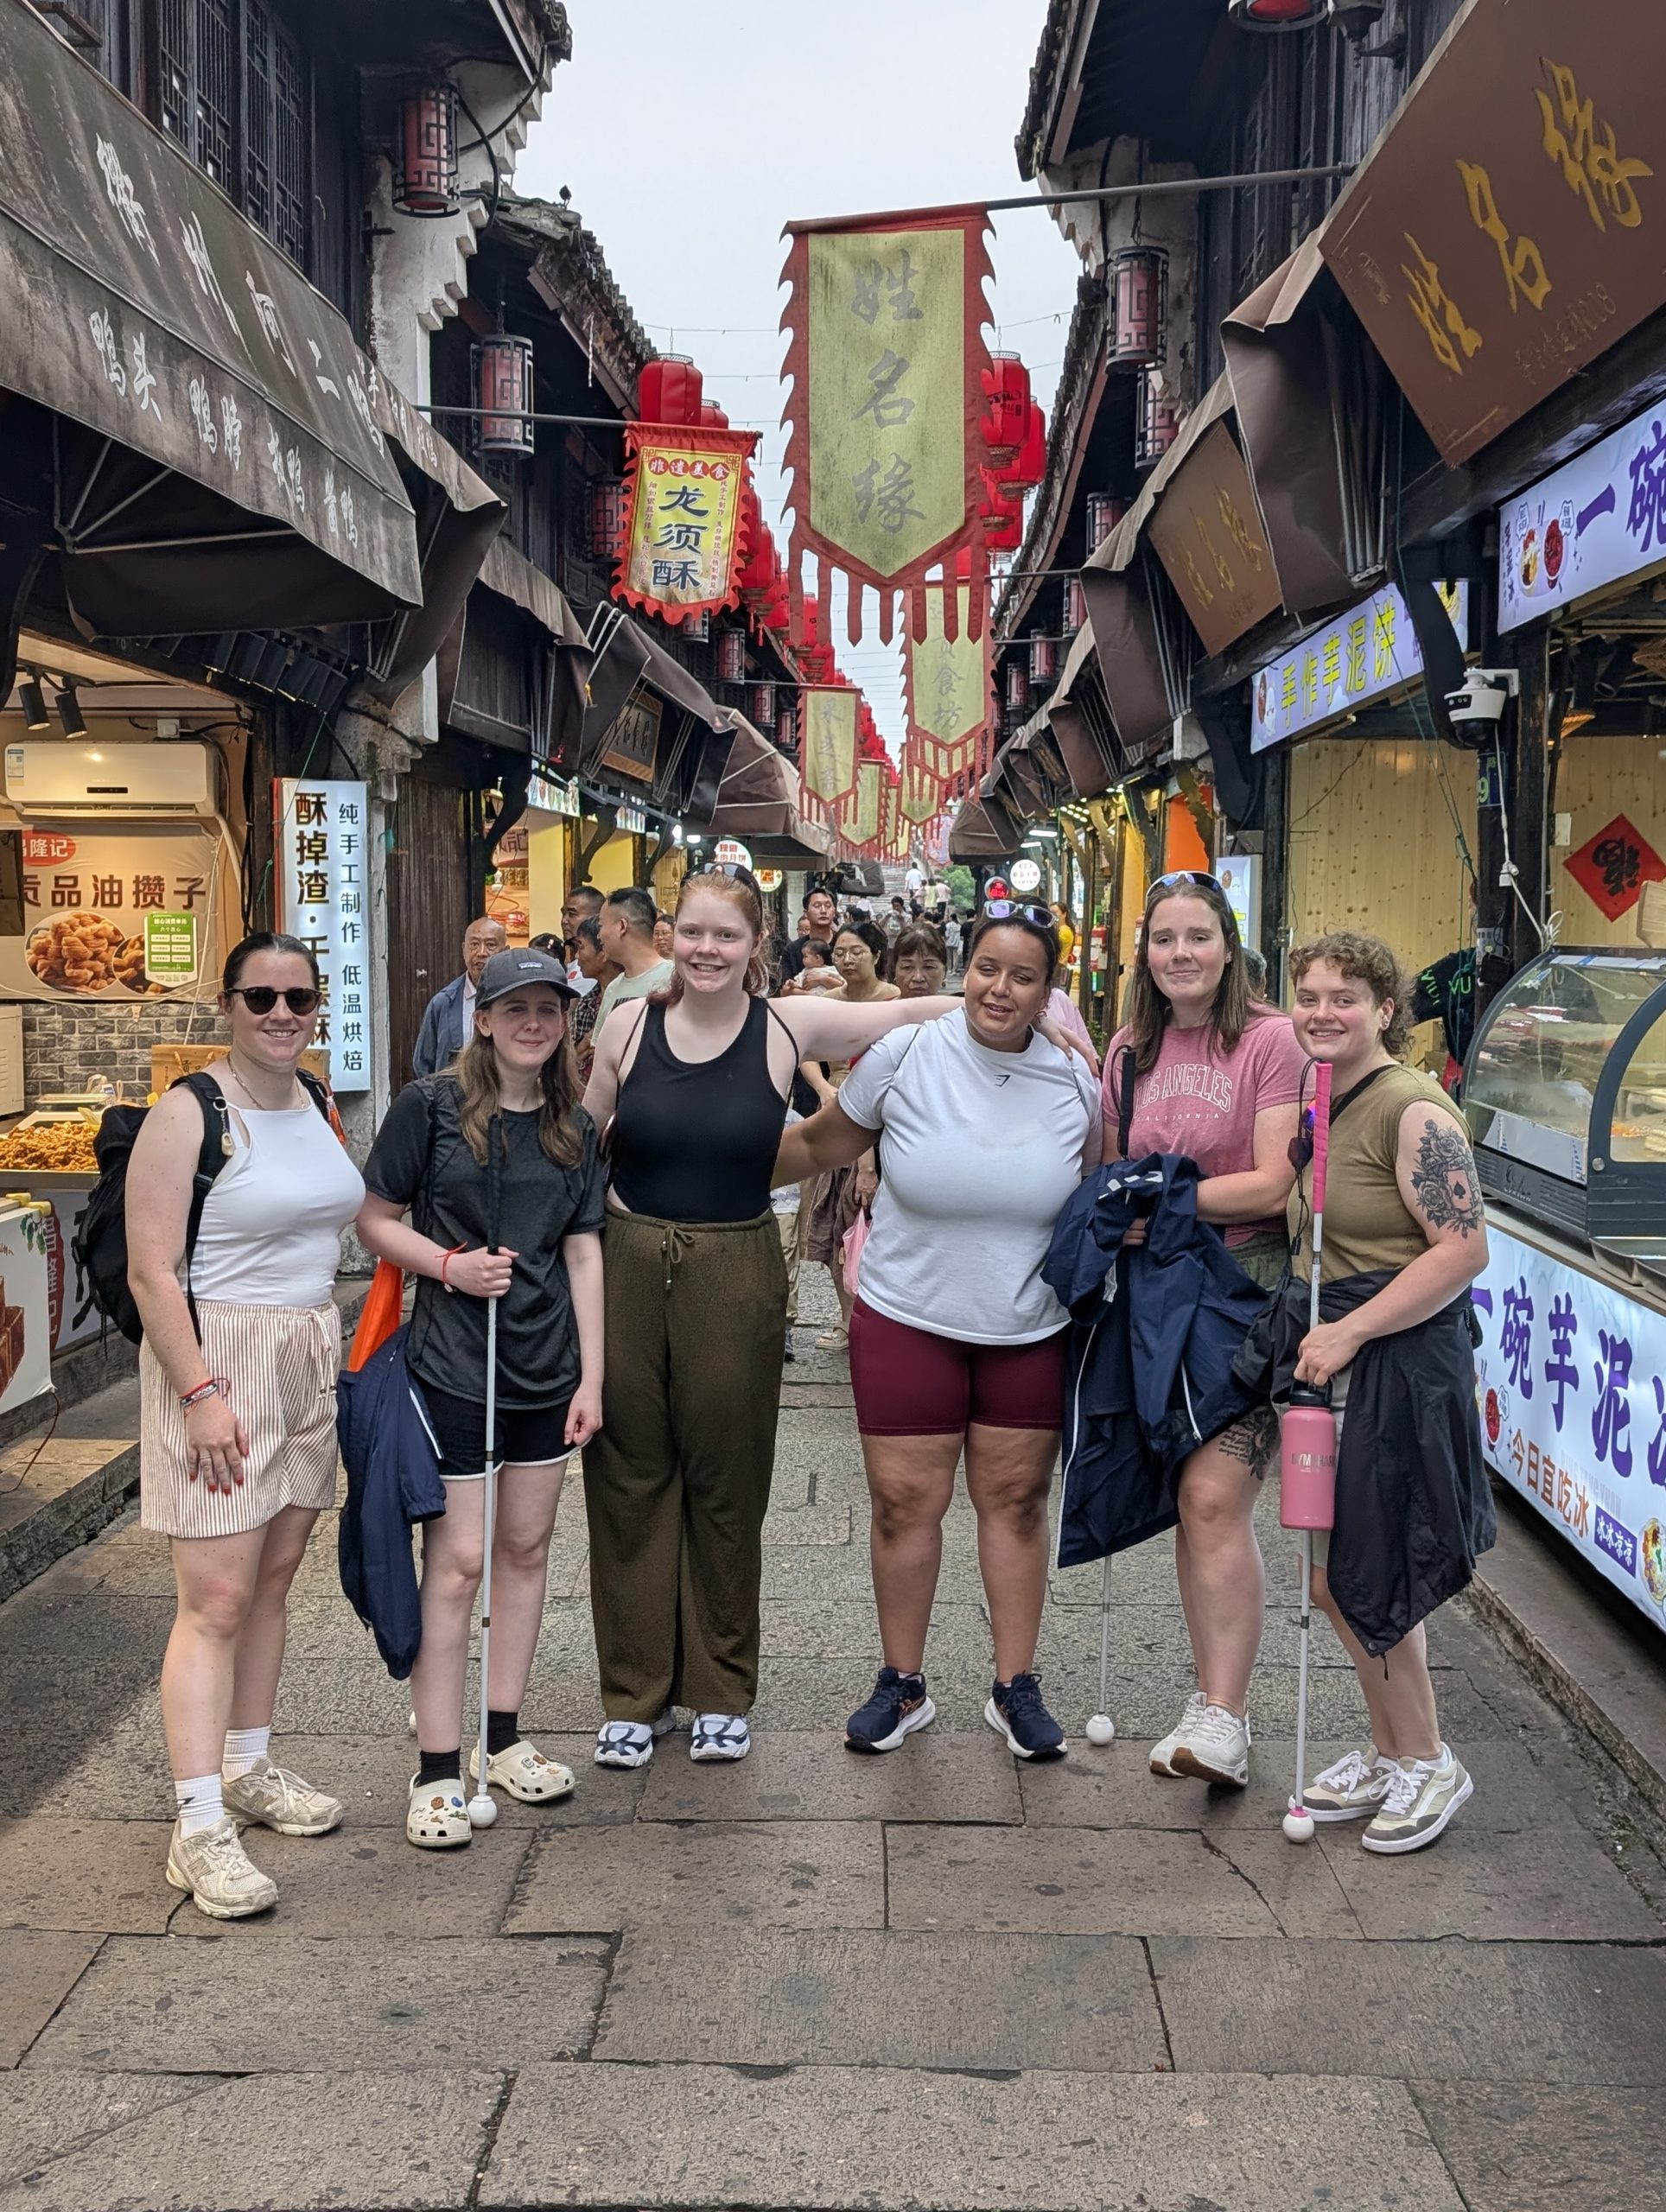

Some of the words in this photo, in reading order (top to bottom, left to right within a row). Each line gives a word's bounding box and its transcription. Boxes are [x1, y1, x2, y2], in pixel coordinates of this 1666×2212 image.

[850, 248, 925, 534] 姓名缘
[649, 459, 730, 478] 非遗美食
[652, 485, 710, 589] 龙须酥
[1281, 594, 1396, 729] 手作芋泥饼
[22, 838, 69, 858] 隆记
[338, 802, 362, 944] 纯手工制作
[341, 963, 363, 1071] 低温烘焙
[1133, 1071, 1161, 1120] LOS
[1161, 1063, 1233, 1114] ANGELES
[1136, 1111, 1220, 1122] CALIFORNIA
[1512, 1427, 1590, 1539] 今日宜吃冰
